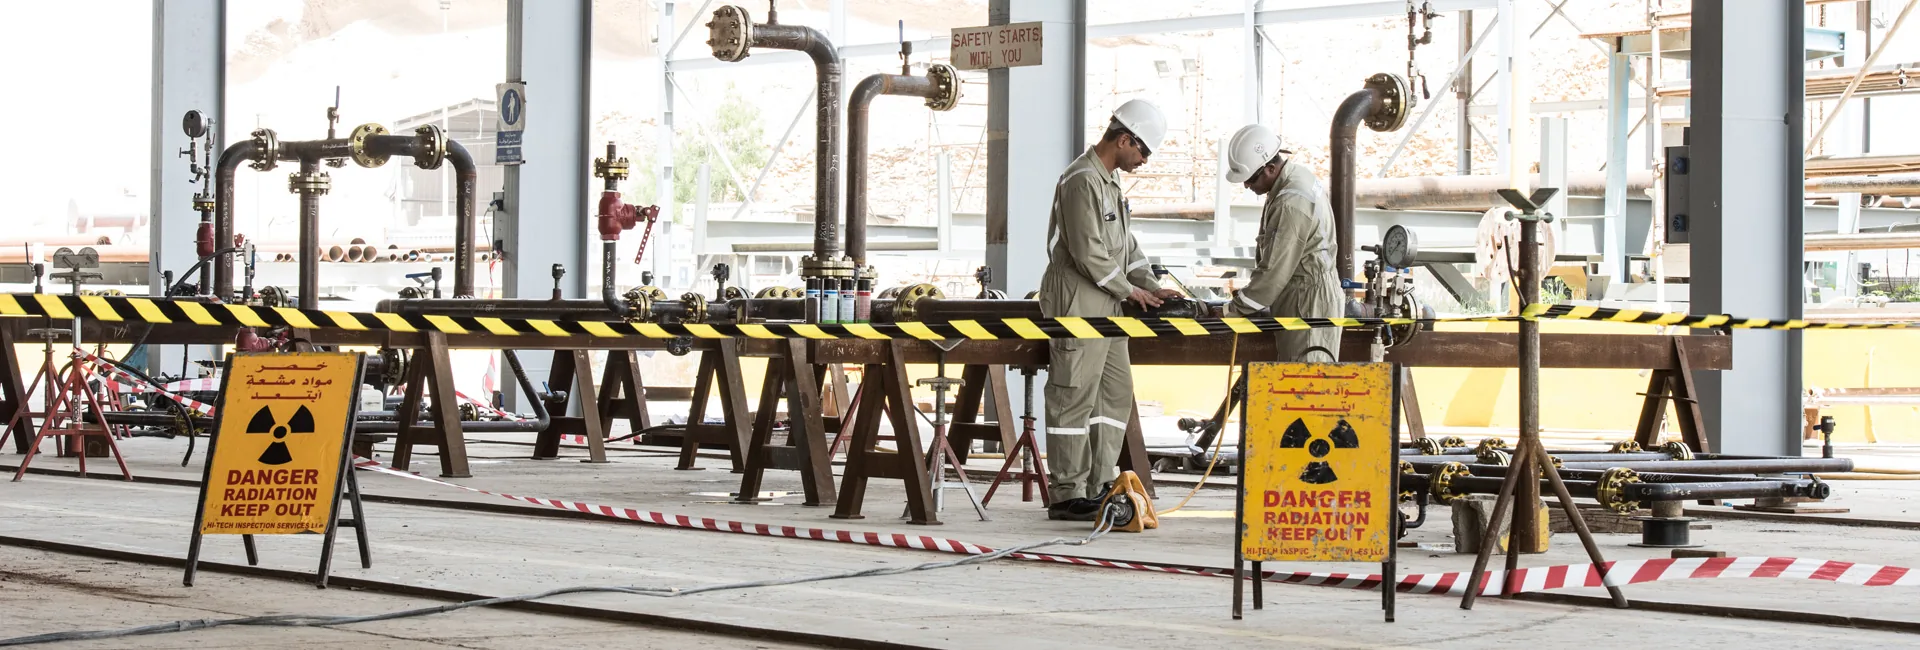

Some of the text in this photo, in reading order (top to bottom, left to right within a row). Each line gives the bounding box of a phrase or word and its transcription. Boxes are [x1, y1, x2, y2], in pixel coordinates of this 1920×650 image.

[953, 27, 1040, 48] SAFETY STARTS
[970, 48, 1022, 66] WITH YOU
[246, 374, 333, 388] مواد مشعة
[226, 469, 319, 485] DANGER
[223, 488, 318, 501] RADIATION
[1263, 490, 1372, 508] DANGER
[220, 503, 315, 517] KEEP OUT
[206, 521, 234, 529] HI-TECH
[235, 521, 276, 529] INSPECTION
[1263, 511, 1369, 525] RADIATION
[1267, 527, 1366, 541] KEEP OUT
